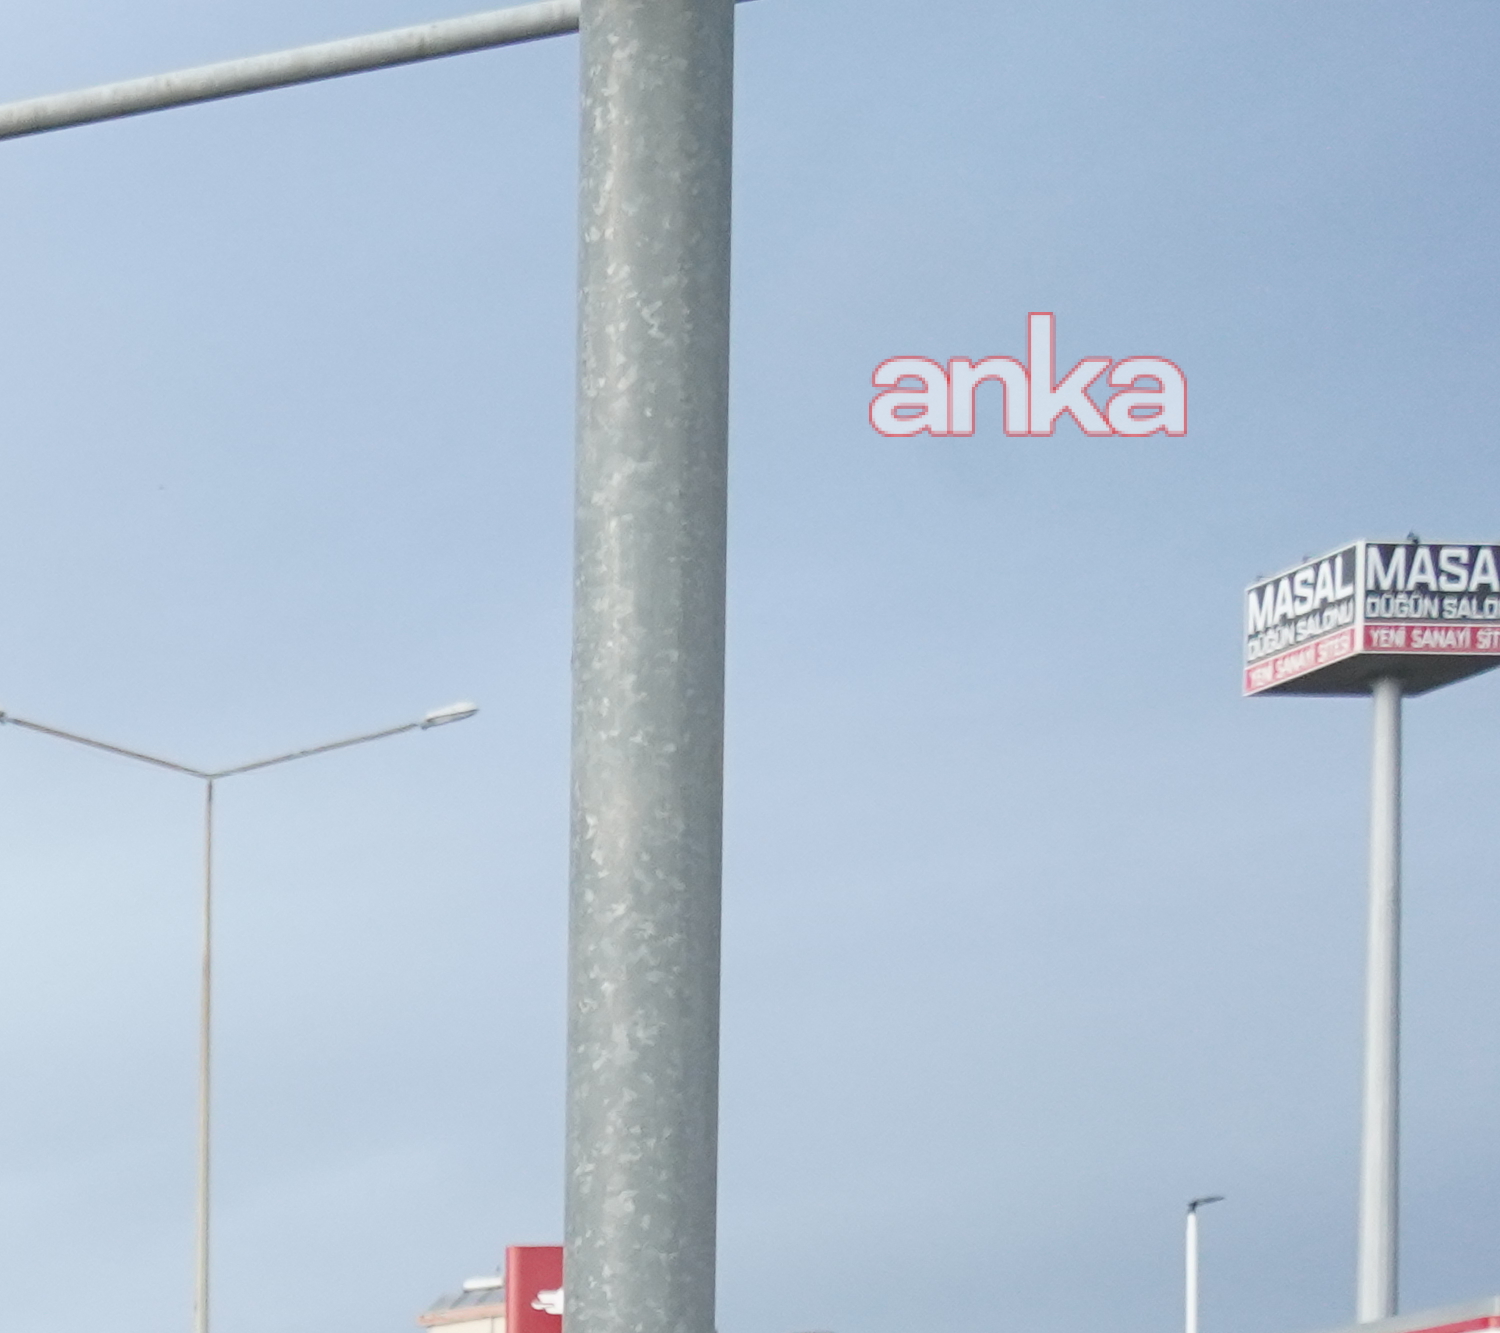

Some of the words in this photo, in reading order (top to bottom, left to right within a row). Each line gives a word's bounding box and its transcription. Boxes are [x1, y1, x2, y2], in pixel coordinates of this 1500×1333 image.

[1366, 545, 1500, 592] MASA
[1247, 554, 1354, 634] MASAL
[1366, 591, 1439, 618] DÜĞÜN
